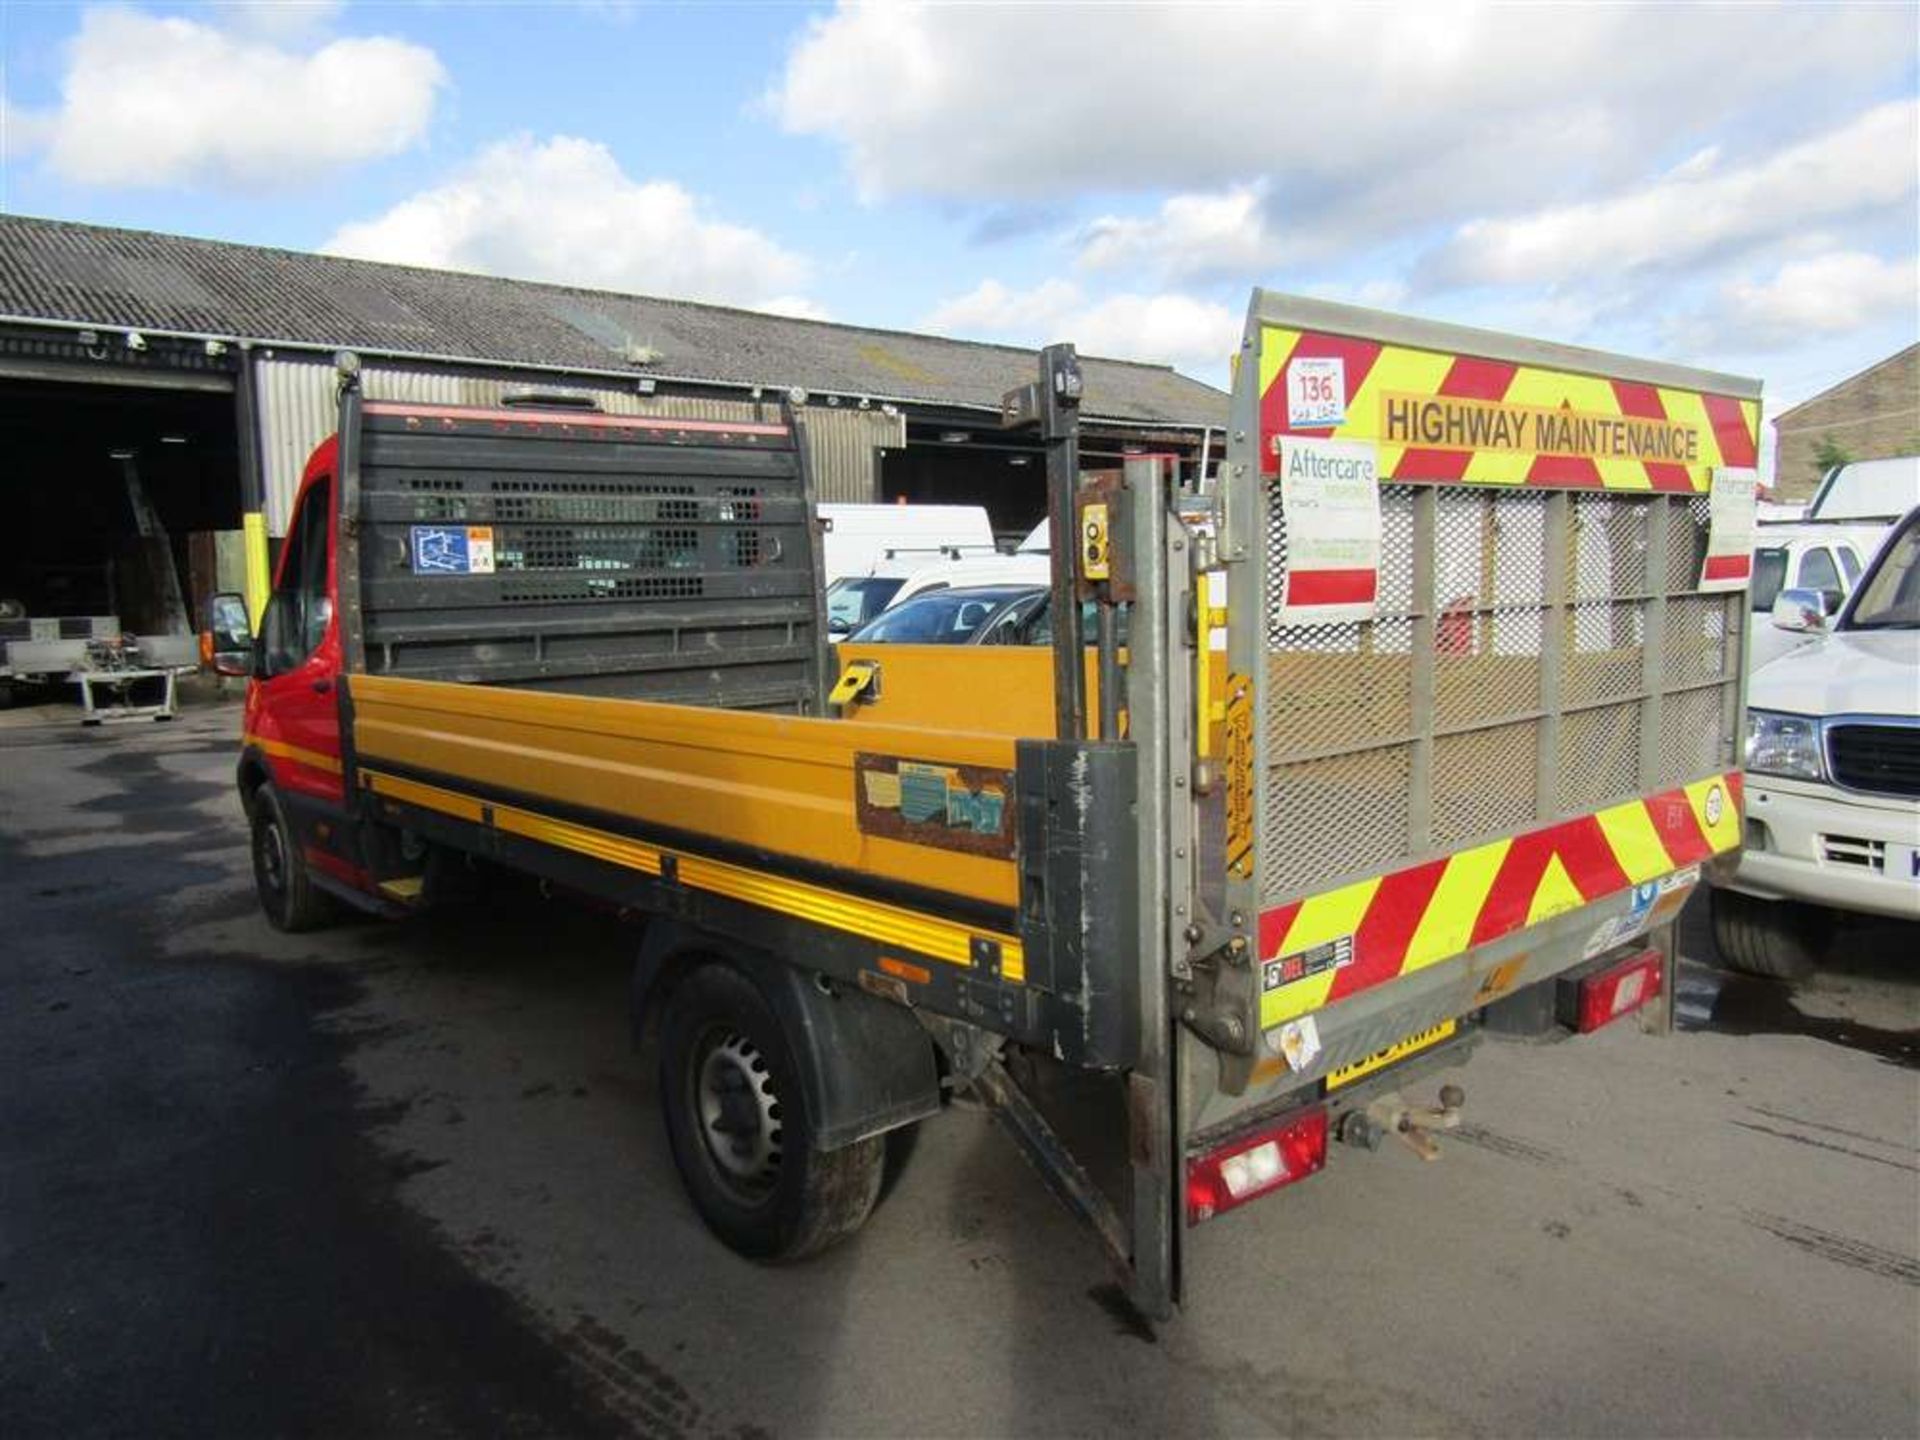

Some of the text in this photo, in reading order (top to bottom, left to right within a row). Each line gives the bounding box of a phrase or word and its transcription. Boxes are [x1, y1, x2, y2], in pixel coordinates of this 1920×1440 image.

[1298, 376, 1333, 402] 136
[1386, 398, 1698, 461] HIGHWAY MAINTENANCE
[1289, 449, 1374, 481] Aftercare
